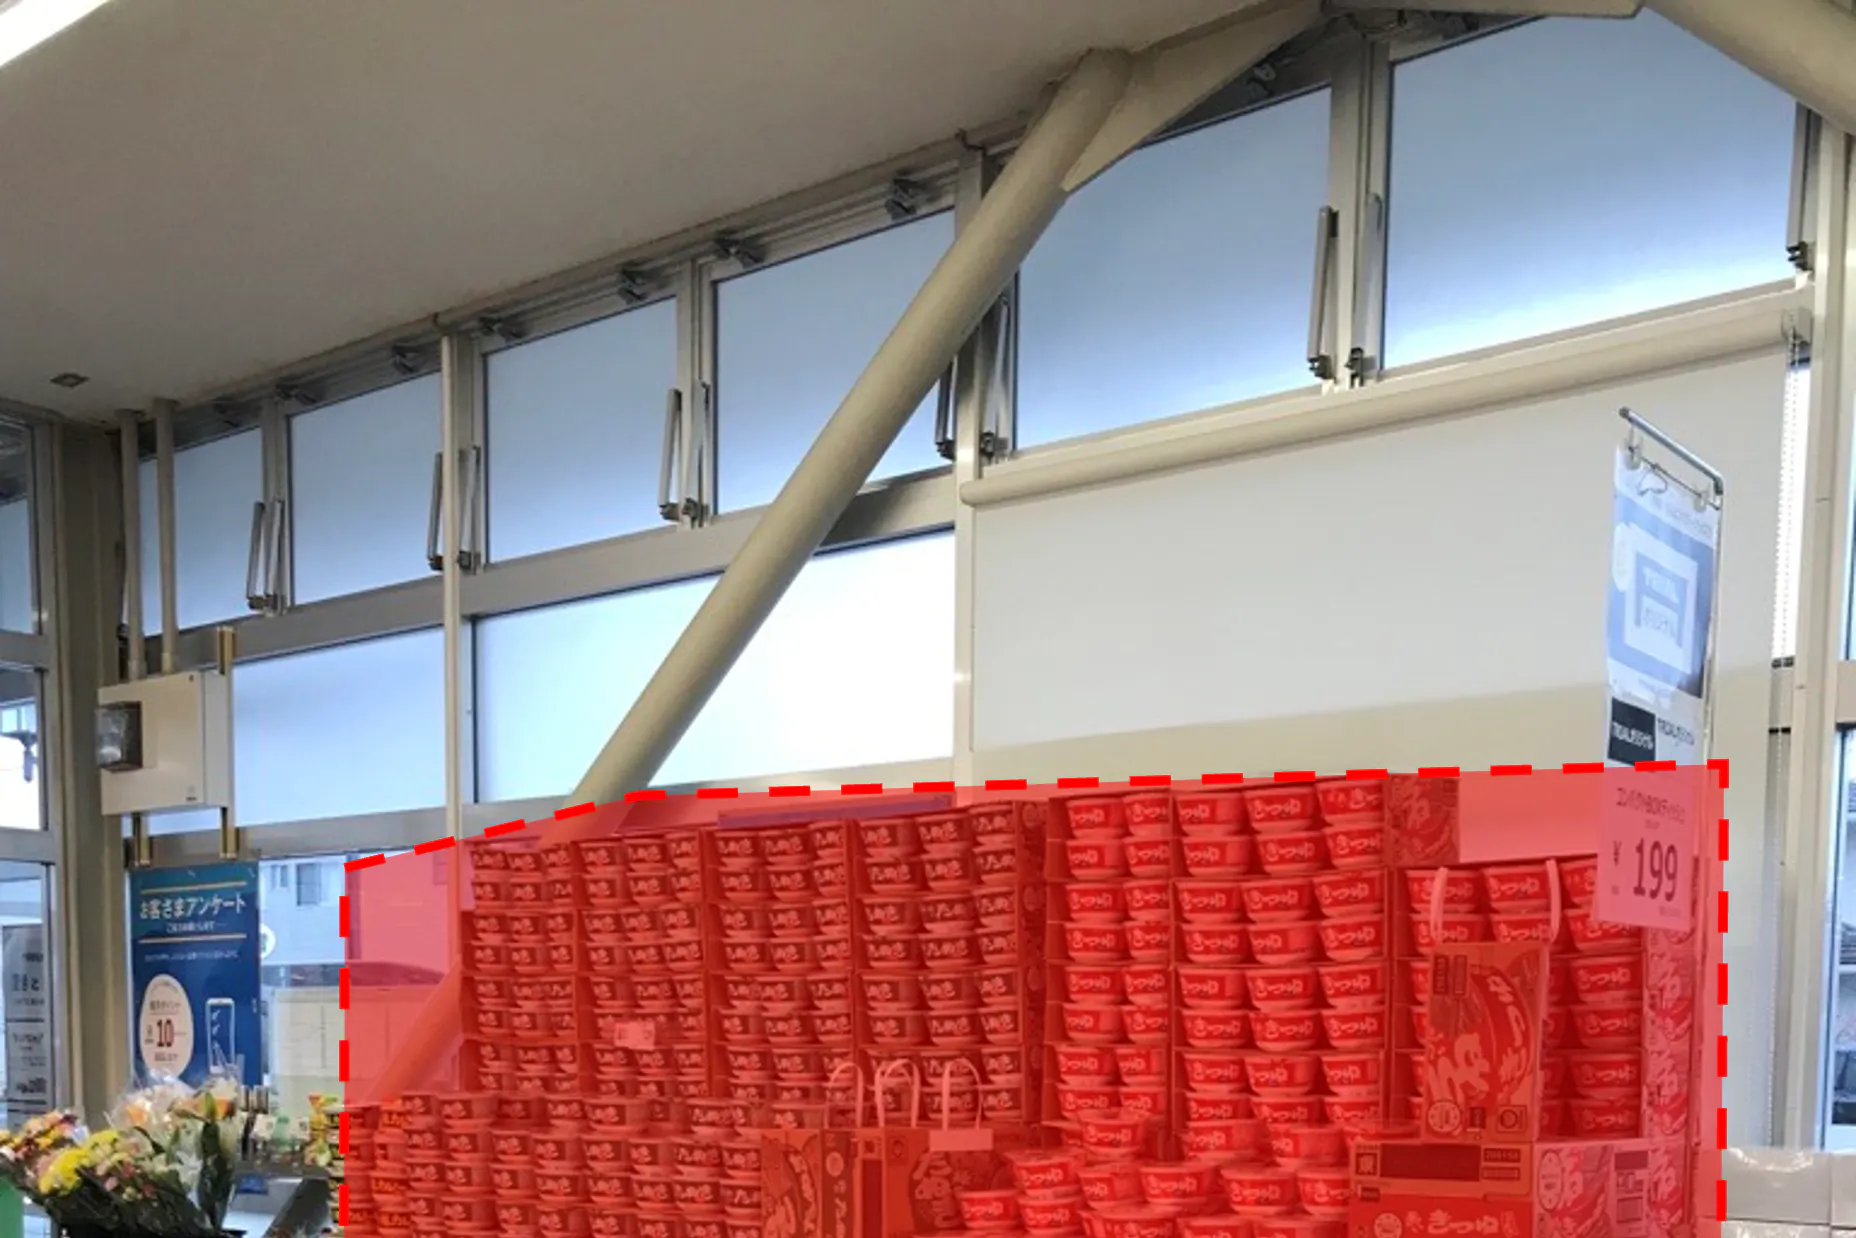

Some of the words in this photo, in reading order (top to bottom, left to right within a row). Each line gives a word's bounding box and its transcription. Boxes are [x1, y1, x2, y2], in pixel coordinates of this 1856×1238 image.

[1633, 837, 1678, 902] 199
[139, 893, 247, 920] お客さまアンケート
[156, 1019, 175, 1048] 10
